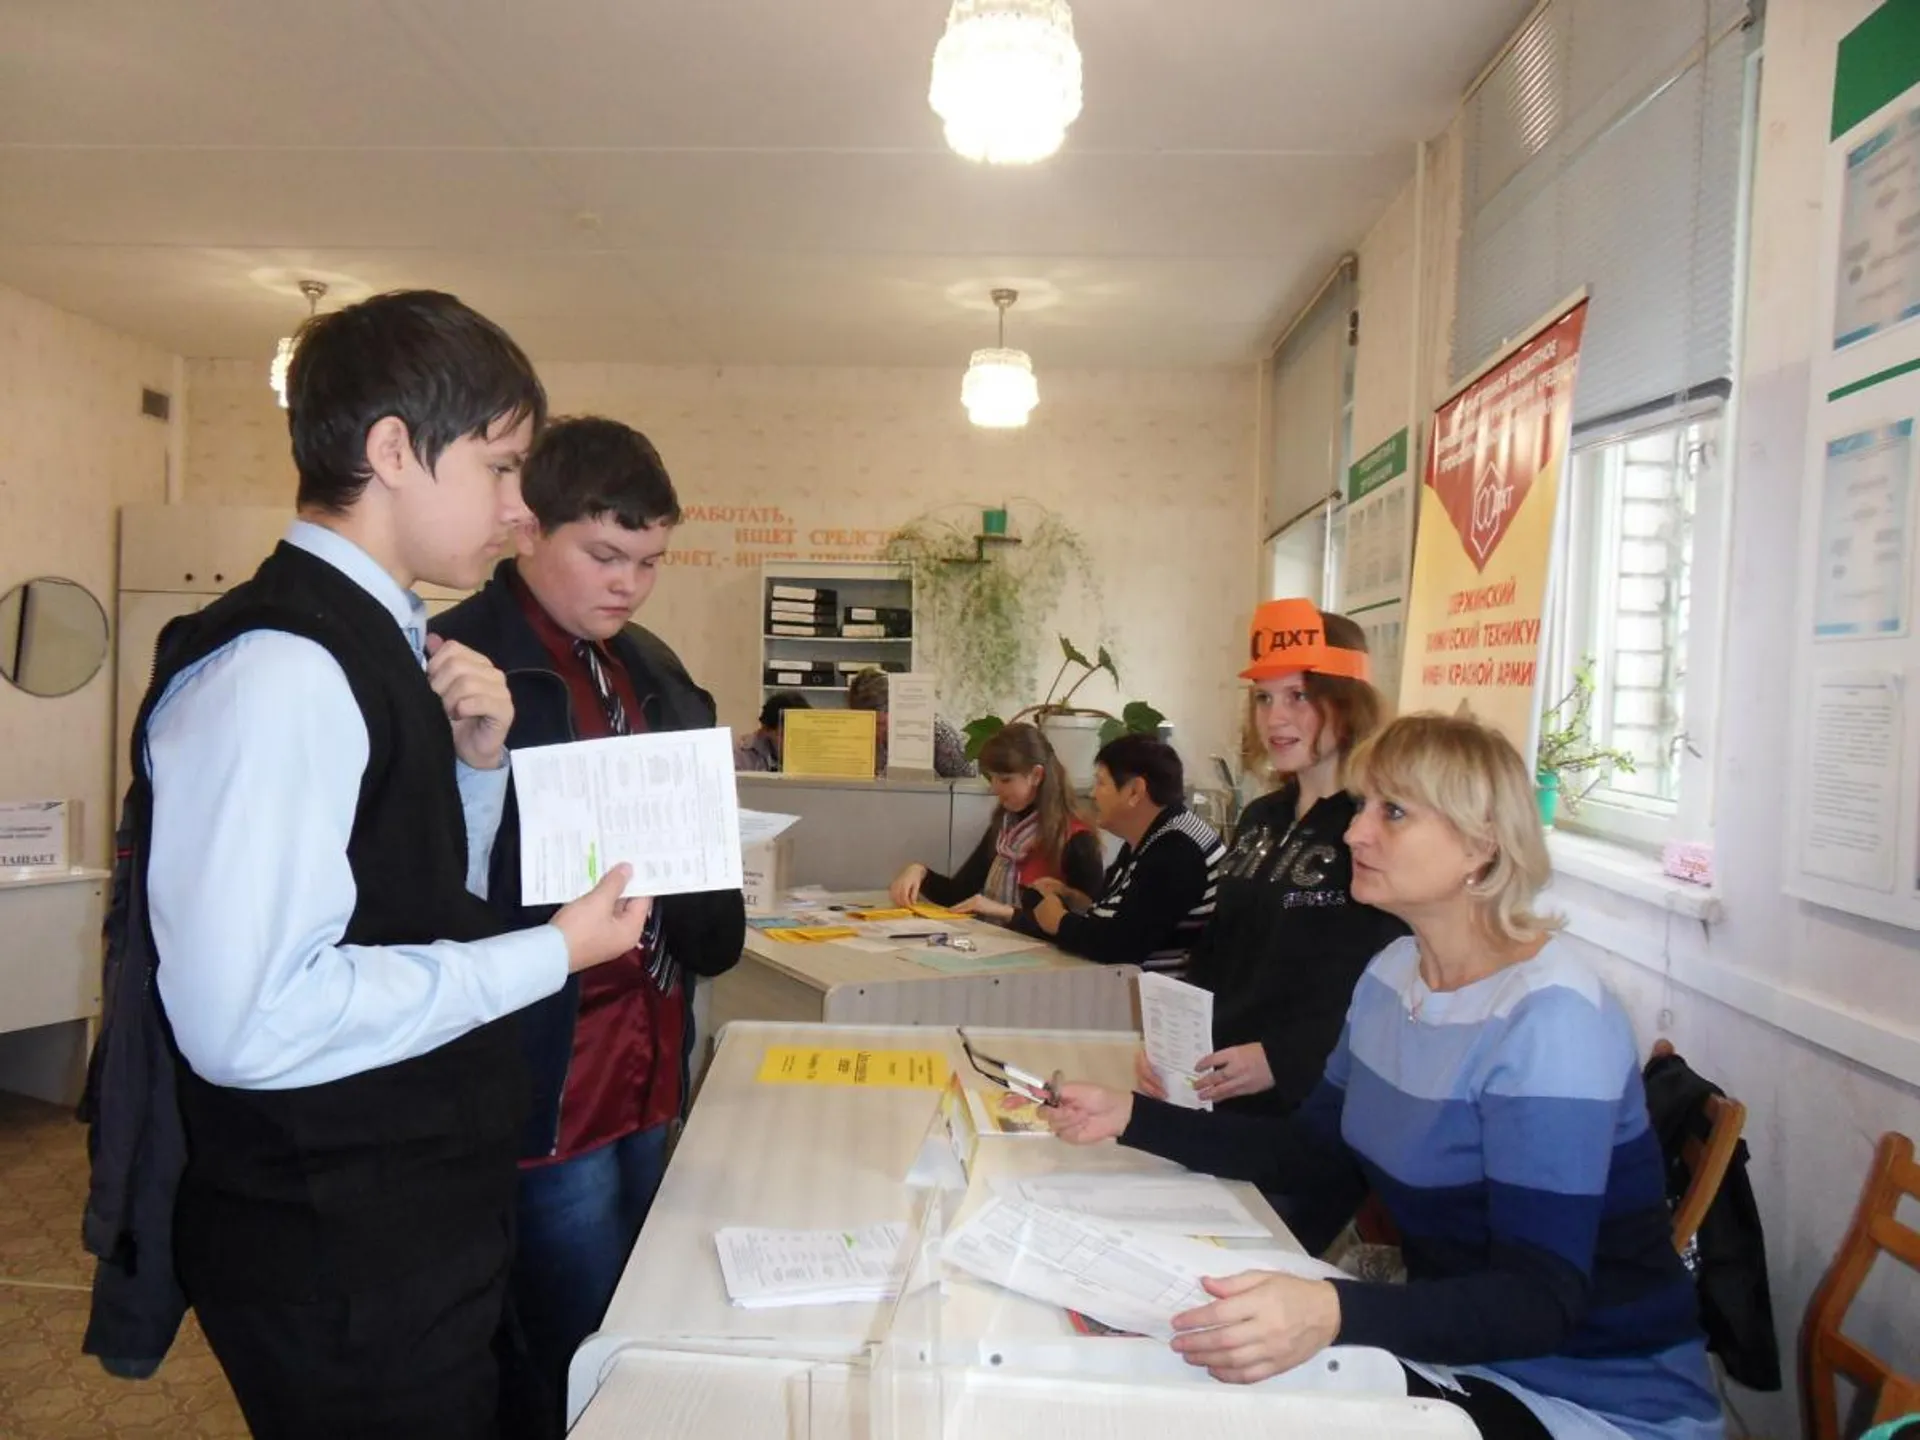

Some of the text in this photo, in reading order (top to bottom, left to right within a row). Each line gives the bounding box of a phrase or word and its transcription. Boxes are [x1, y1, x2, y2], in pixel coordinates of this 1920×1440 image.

[683, 505, 794, 526] РАБОТАТЬ,
[735, 528, 798, 545] ИЩЕТ
[1269, 629, 1320, 652] ДХТ
